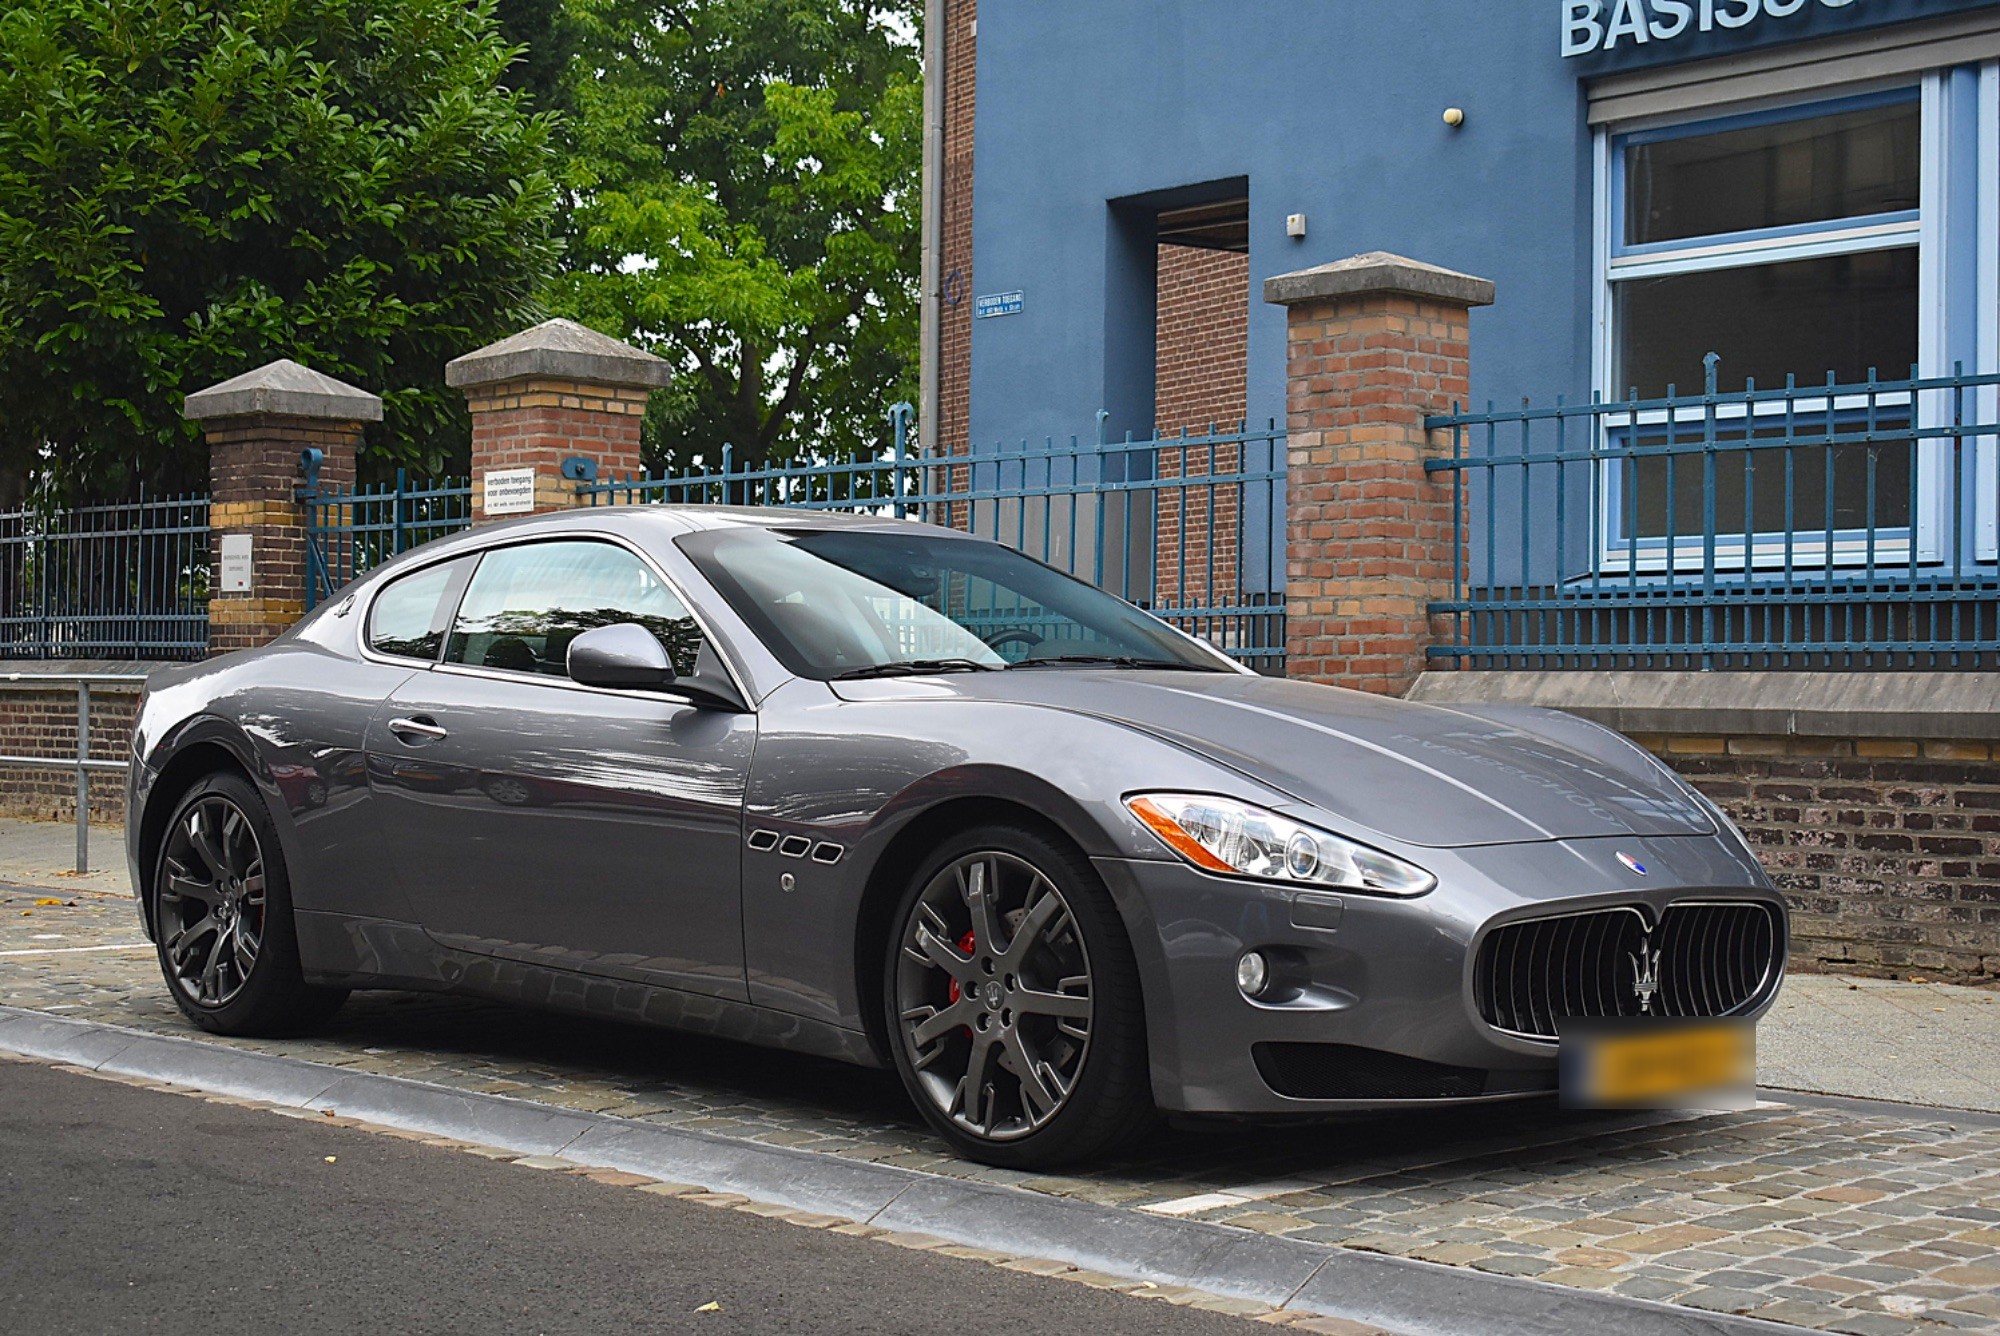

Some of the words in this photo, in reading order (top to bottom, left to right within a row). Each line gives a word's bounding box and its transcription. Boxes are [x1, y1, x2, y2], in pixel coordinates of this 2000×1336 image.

[1561, 0, 1852, 57] BASIS
[488, 477, 509, 485] verboden
[511, 476, 531, 485] toegang
[499, 486, 531, 496] onbevoegden
